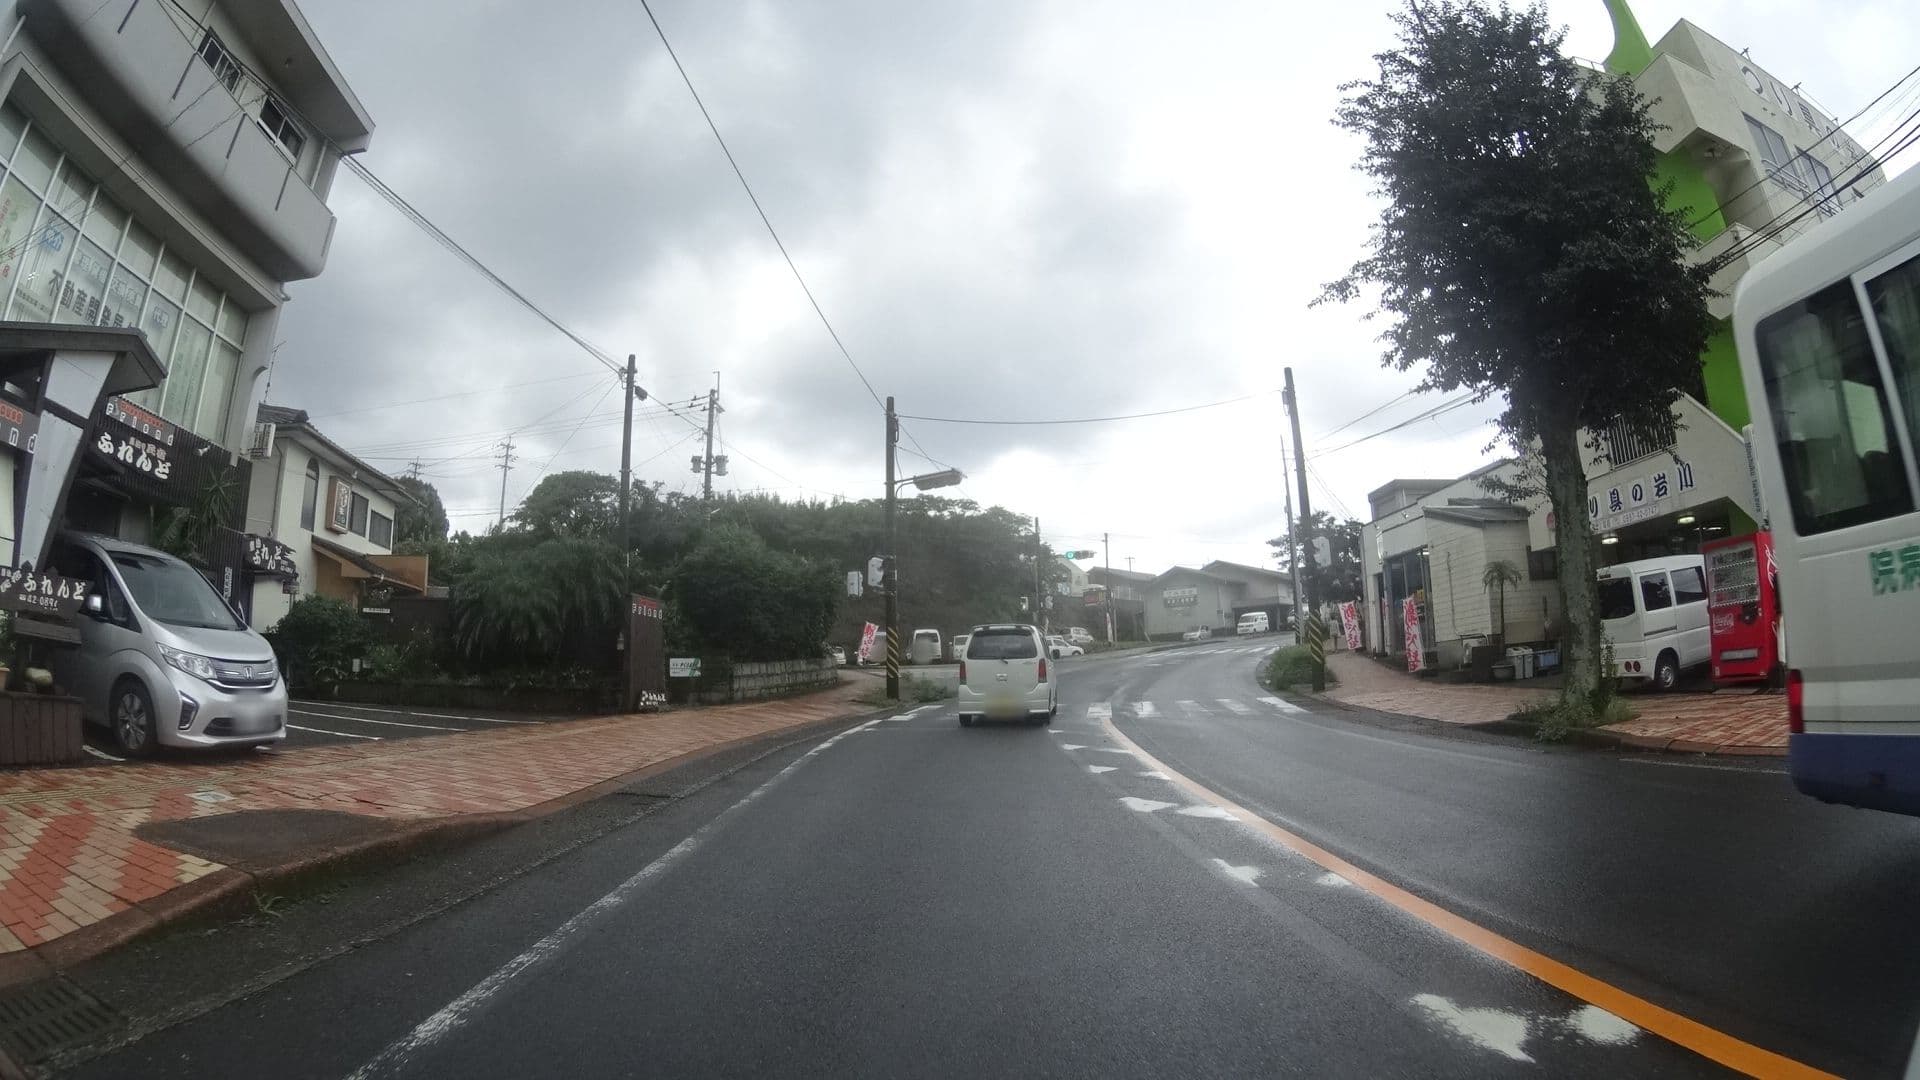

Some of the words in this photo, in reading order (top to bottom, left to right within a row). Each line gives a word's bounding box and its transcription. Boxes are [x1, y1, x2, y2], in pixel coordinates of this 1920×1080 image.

[97, 431, 172, 480] ふれんど
[251, 542, 283, 571] ふれんど
[23, 571, 87, 602] ふれんど
